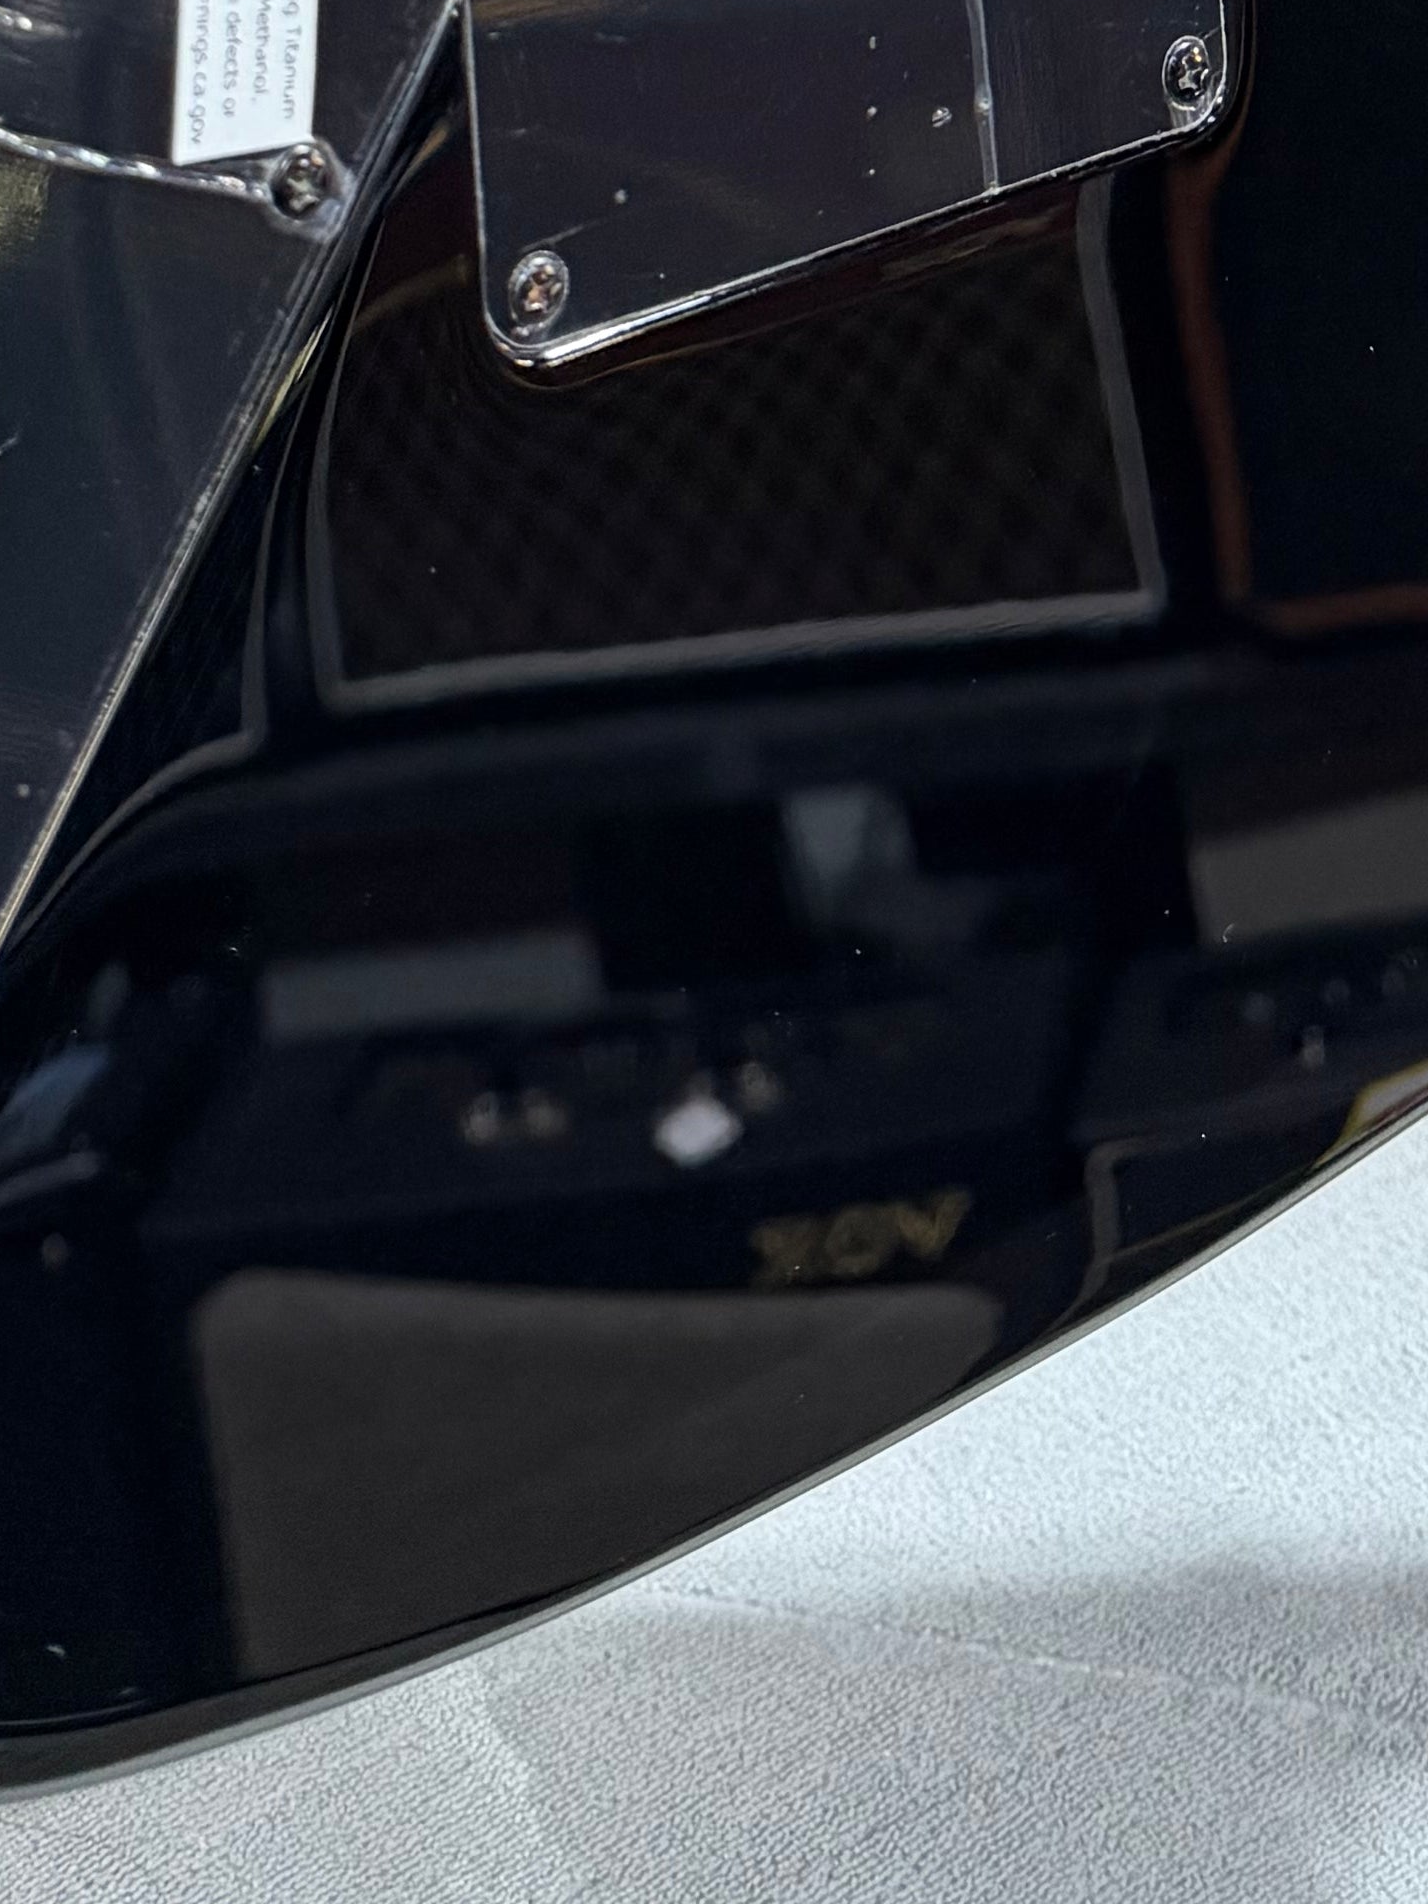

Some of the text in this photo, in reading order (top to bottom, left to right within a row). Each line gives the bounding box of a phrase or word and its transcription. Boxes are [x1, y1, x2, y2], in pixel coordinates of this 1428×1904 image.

[223, 11, 242, 91] defects
[282, 25, 302, 120] Titanium
[222, 96, 237, 119] or
